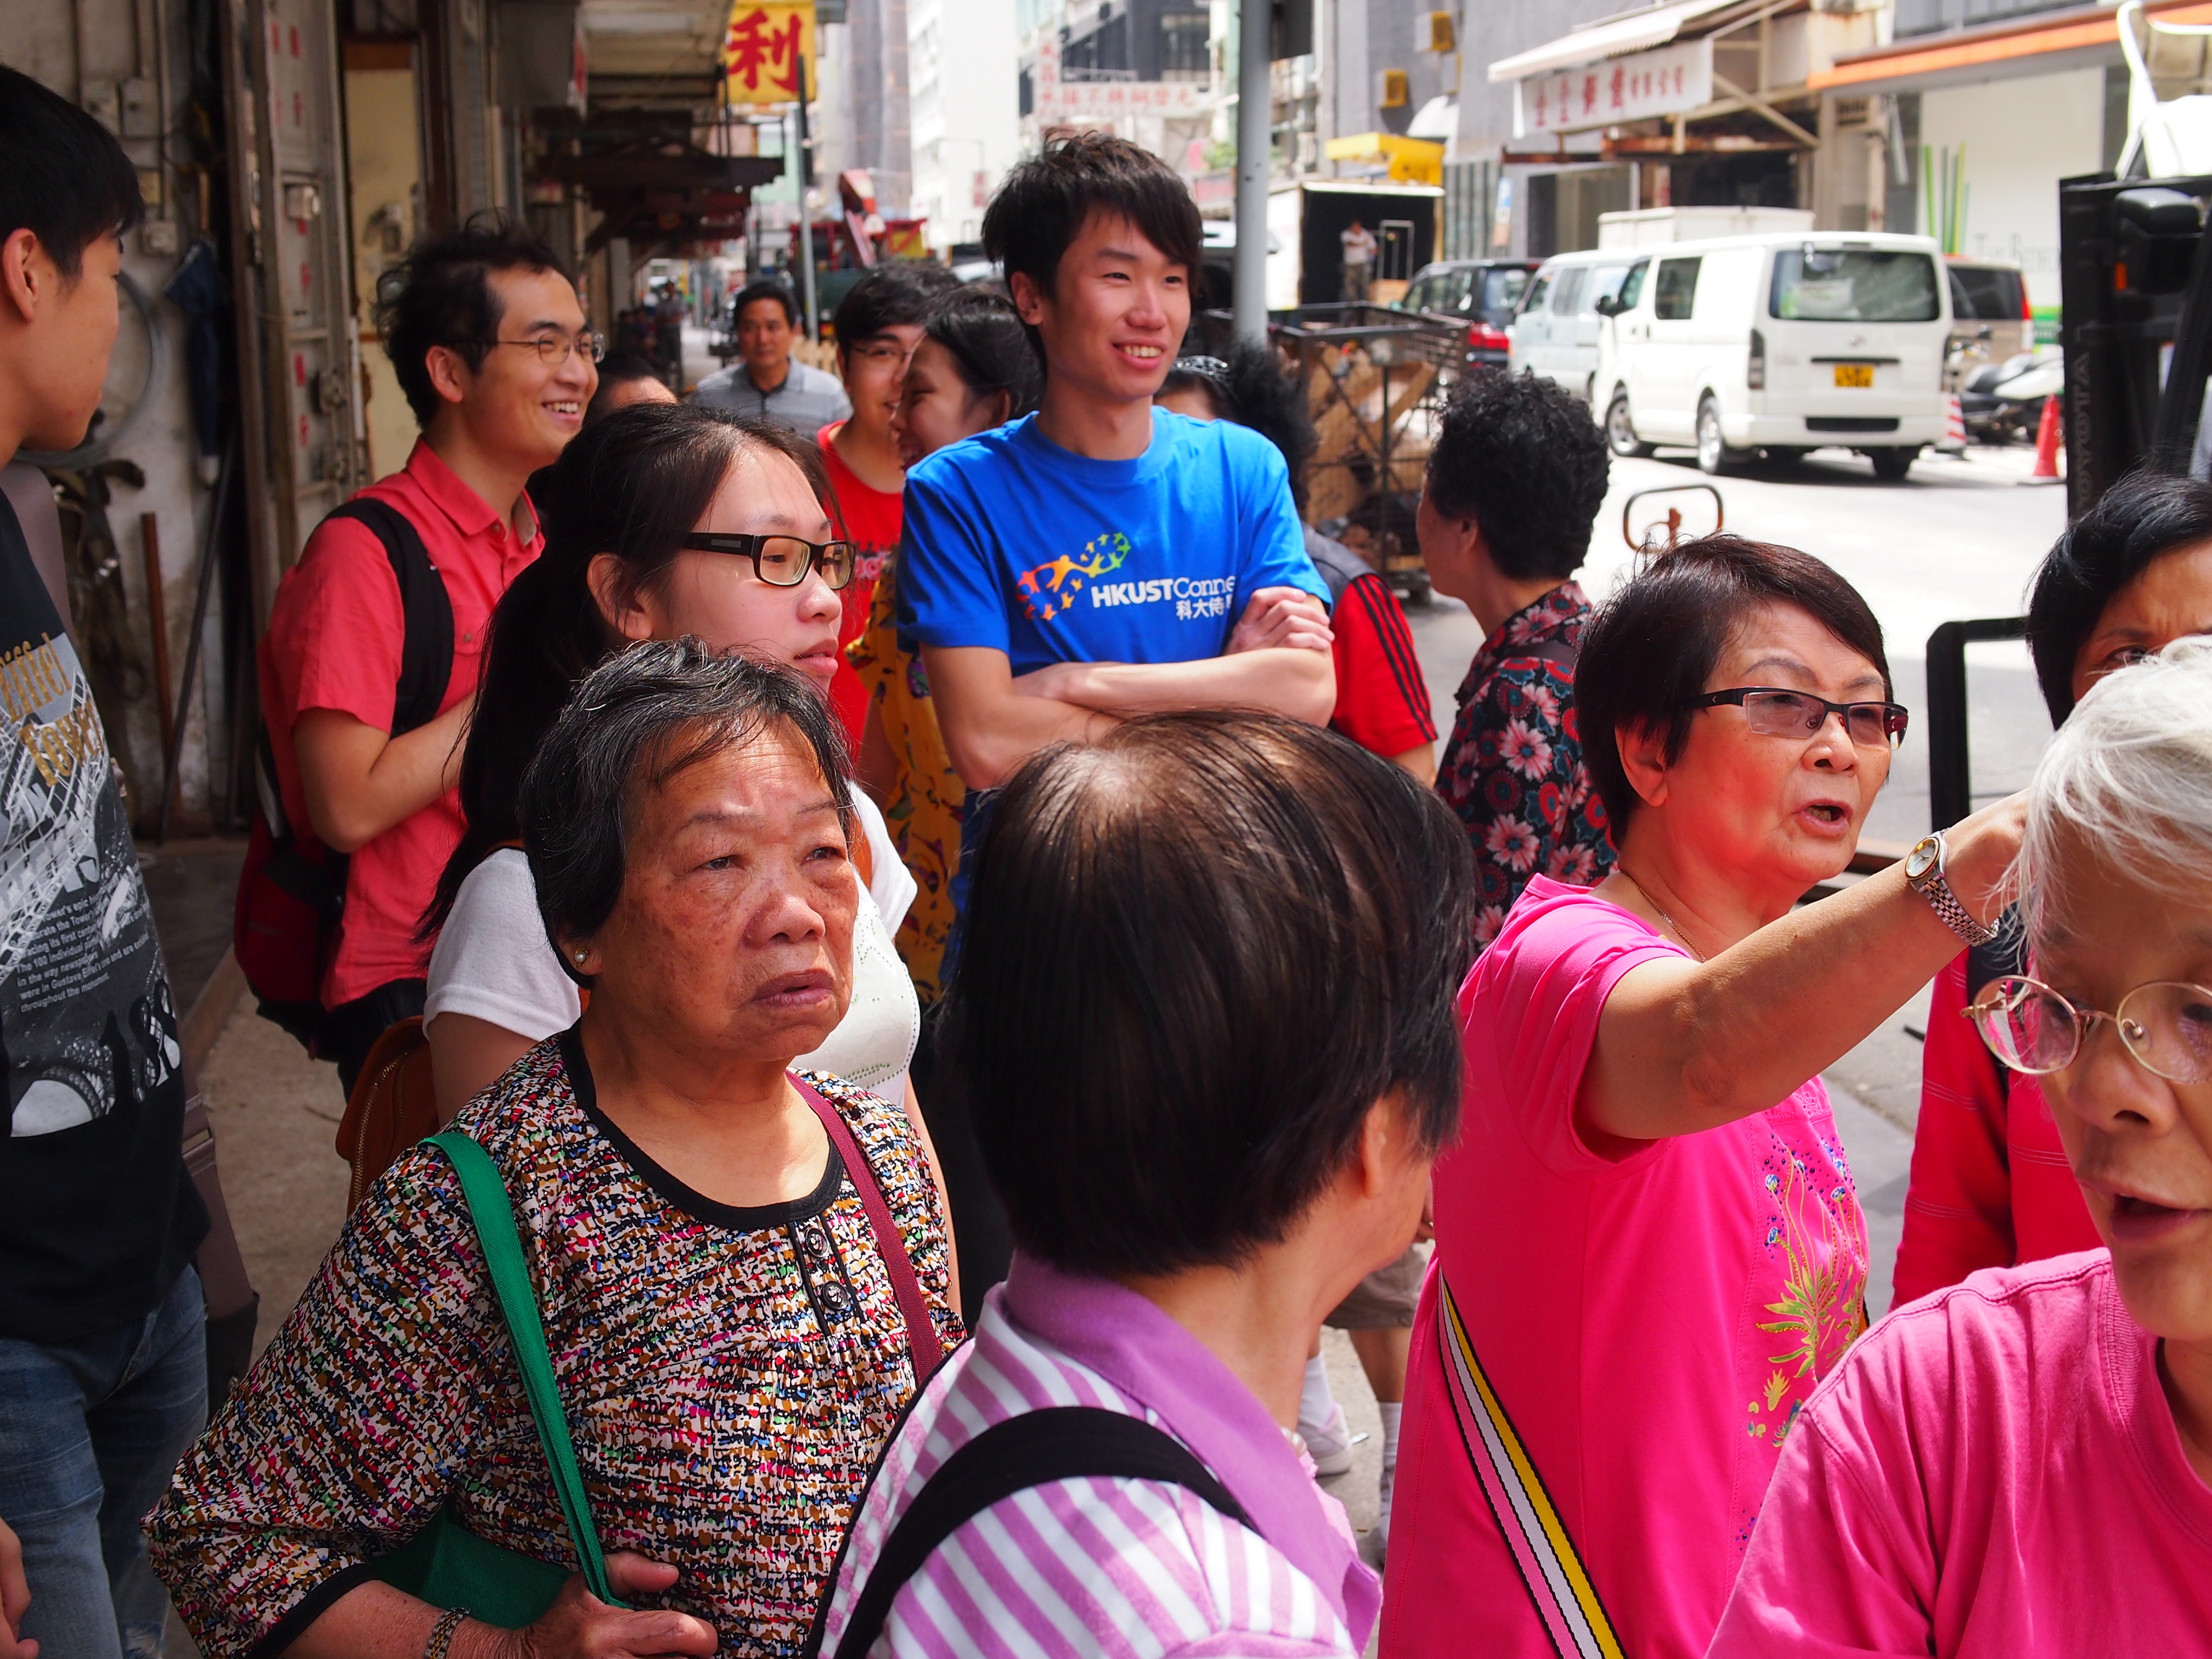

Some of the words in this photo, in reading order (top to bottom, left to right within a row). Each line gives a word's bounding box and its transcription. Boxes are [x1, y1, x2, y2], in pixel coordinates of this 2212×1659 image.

[728, 8, 802, 94] 利
[1091, 575, 1236, 608] HKUSTConne
[73, 898, 88, 912] epic
[48, 938, 61, 948] its
[61, 930, 77, 944] first
[56, 921, 70, 932] the
[33, 955, 48, 968] 100
[48, 941, 84, 963] individual
[17, 978, 27, 987] in
[28, 973, 42, 984] the
[43, 967, 59, 978] way
[19, 988, 41, 1000] were
[42, 984, 50, 993] in
[51, 972, 82, 989] Gustave
[110, 949, 123, 962] and
[122, 944, 134, 956] are
[21, 989, 66, 1013] throughout
[66, 987, 81, 997] the
